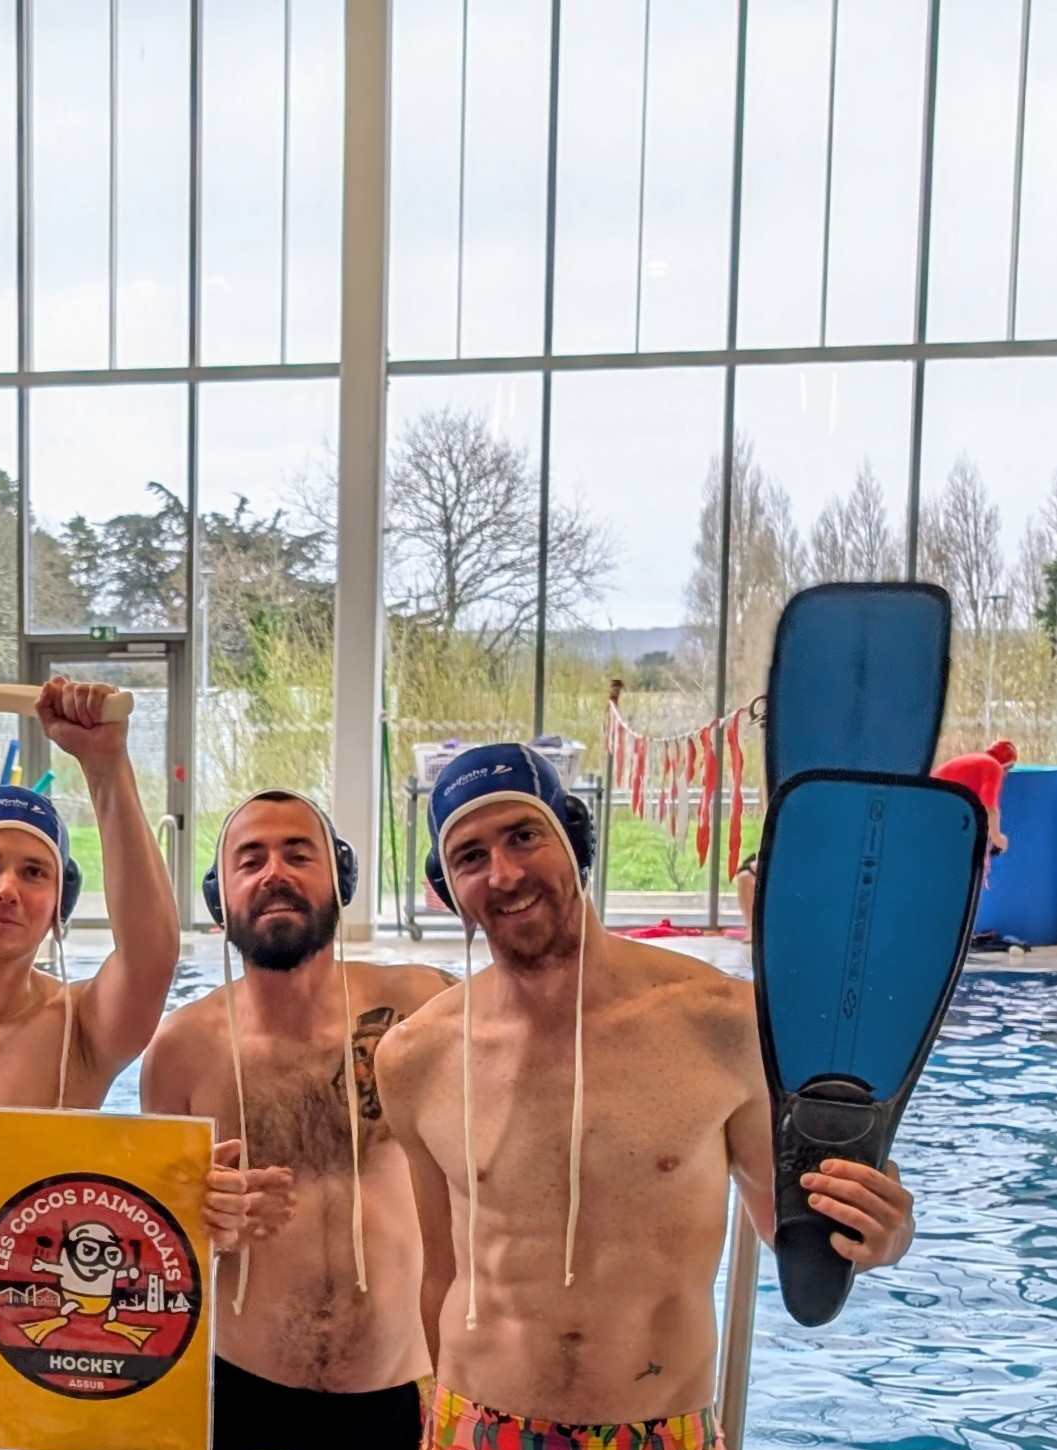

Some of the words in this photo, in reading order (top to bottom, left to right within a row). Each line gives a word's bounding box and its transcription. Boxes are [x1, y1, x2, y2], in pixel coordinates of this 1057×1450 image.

[10, 1188, 78, 1234] COCOS
[82, 1188, 182, 1282] PAIMPOLAIS
[49, 1354, 126, 1375] HOCKEY
